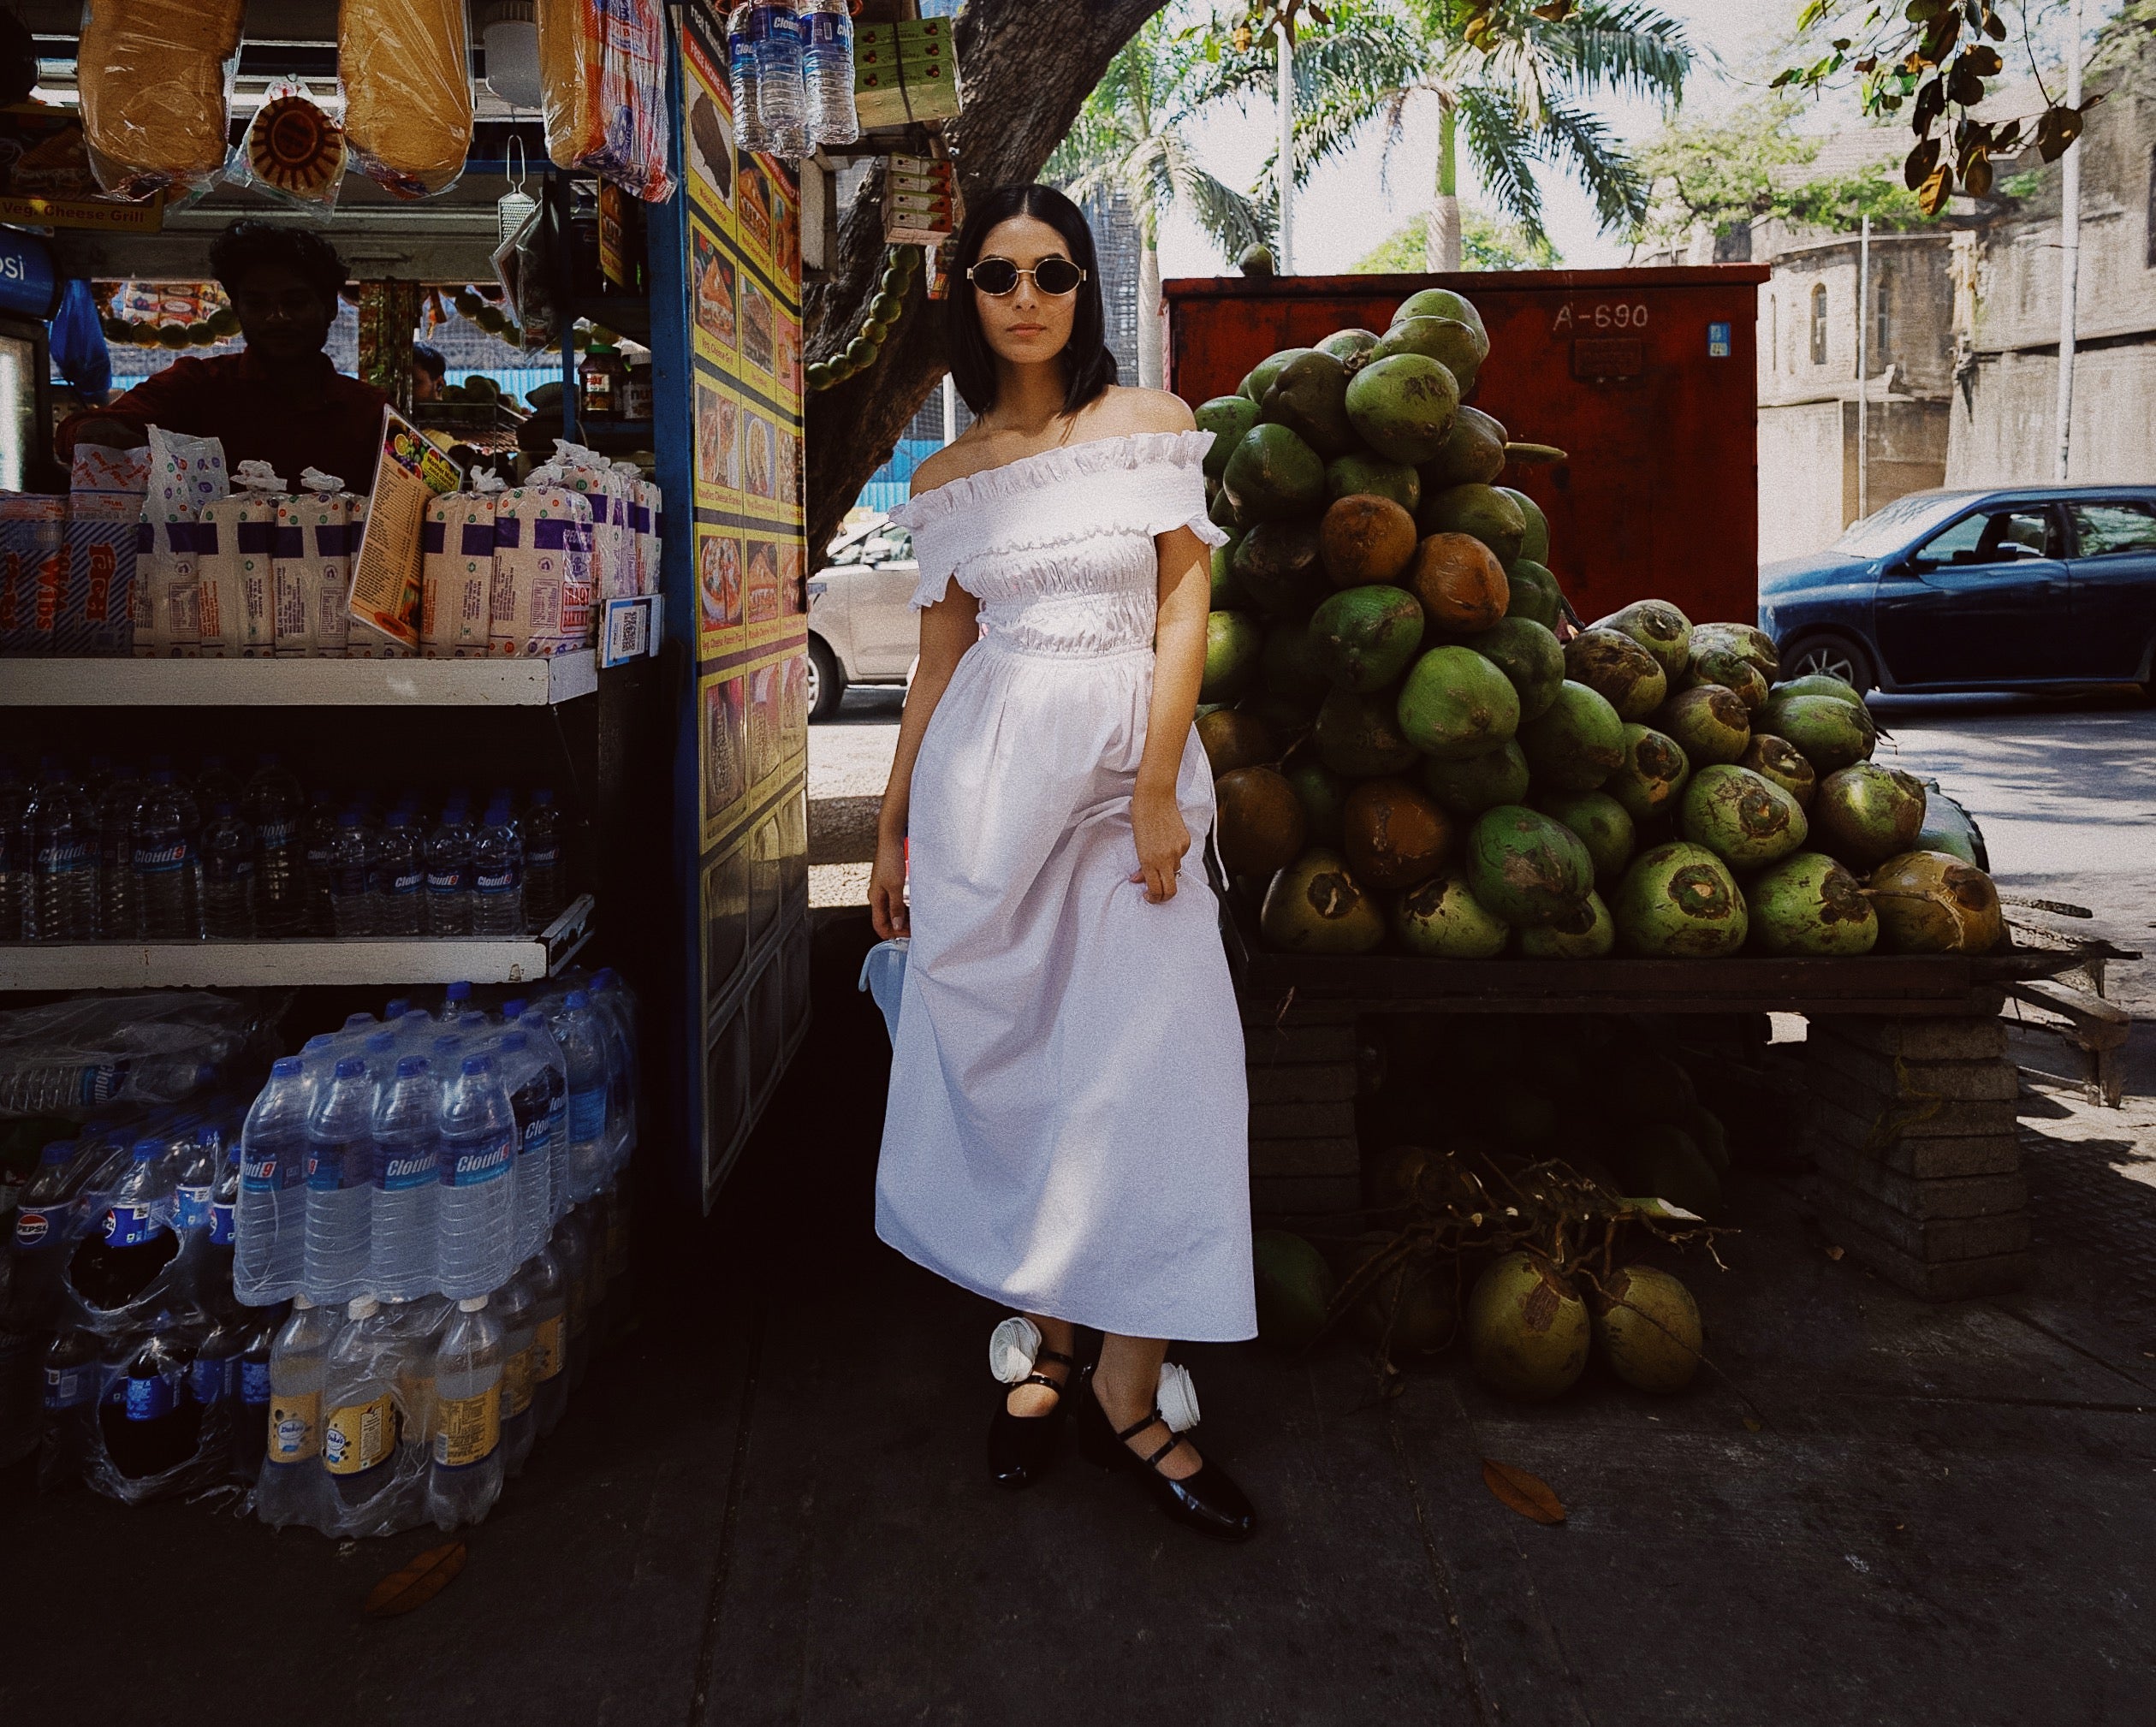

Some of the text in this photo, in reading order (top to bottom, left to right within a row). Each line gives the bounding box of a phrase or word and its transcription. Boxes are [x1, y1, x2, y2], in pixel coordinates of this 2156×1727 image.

[44, 205, 105, 220] Cheese
[110, 210, 145, 223] Grill
[0, 254, 25, 281] si
[1553, 303, 1648, 331] A-690
[37, 556, 59, 629] Wibs
[564, 588, 590, 607] IRAQI
[134, 845, 187, 864] Cloud9
[477, 873, 513, 887] Cloud9
[387, 1152, 437, 1177] Cloud
[17, 1224, 48, 1233] PEPSI
